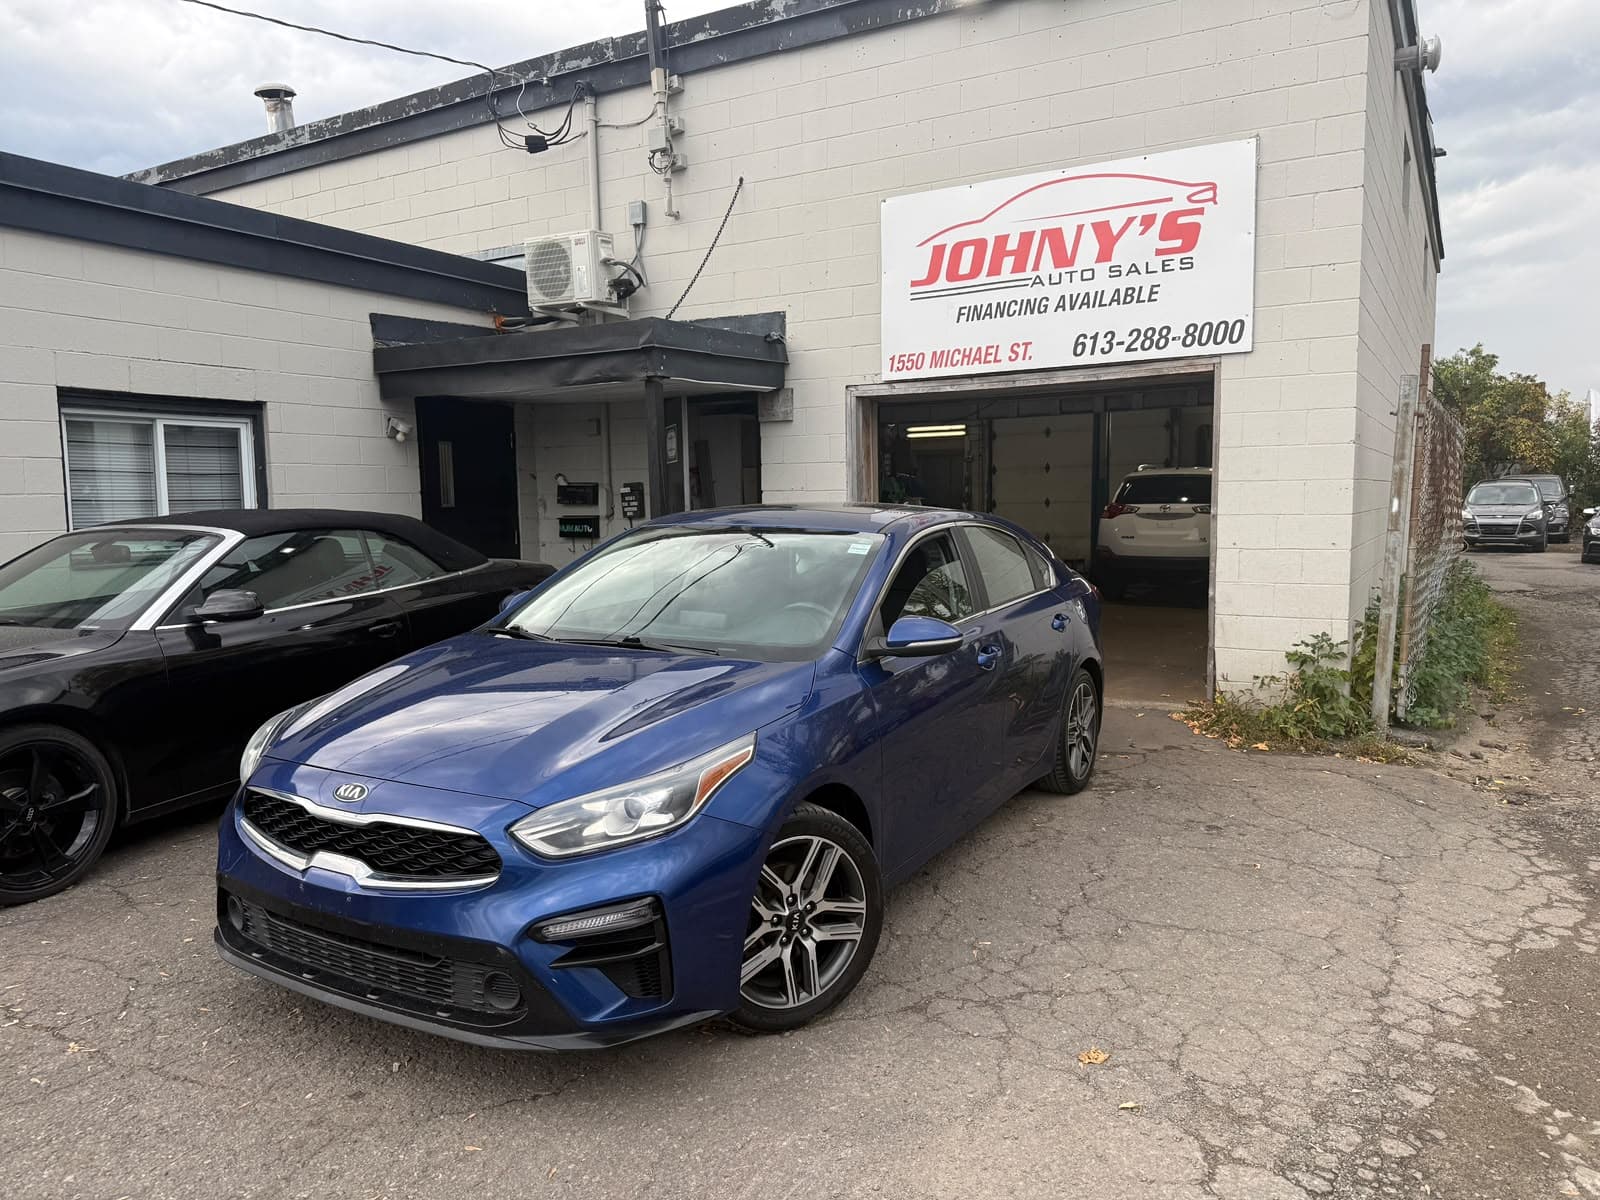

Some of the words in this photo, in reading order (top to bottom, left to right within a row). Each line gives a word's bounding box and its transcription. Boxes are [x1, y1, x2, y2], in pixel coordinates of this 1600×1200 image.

[911, 207, 1205, 287] JOHNY'S
[1030, 268, 1096, 288] AUTO
[1108, 257, 1194, 279] SALES
[956, 298, 1050, 324] FINANCING
[1055, 284, 1161, 313] AVAILABLE
[1072, 319, 1246, 357] 613-288-8000
[888, 353, 925, 373] 1550
[929, 346, 1003, 369] MICHAEL
[1008, 342, 1033, 362] ST.
[336, 784, 362, 799] KIA
[791, 913, 800, 930] KIA
